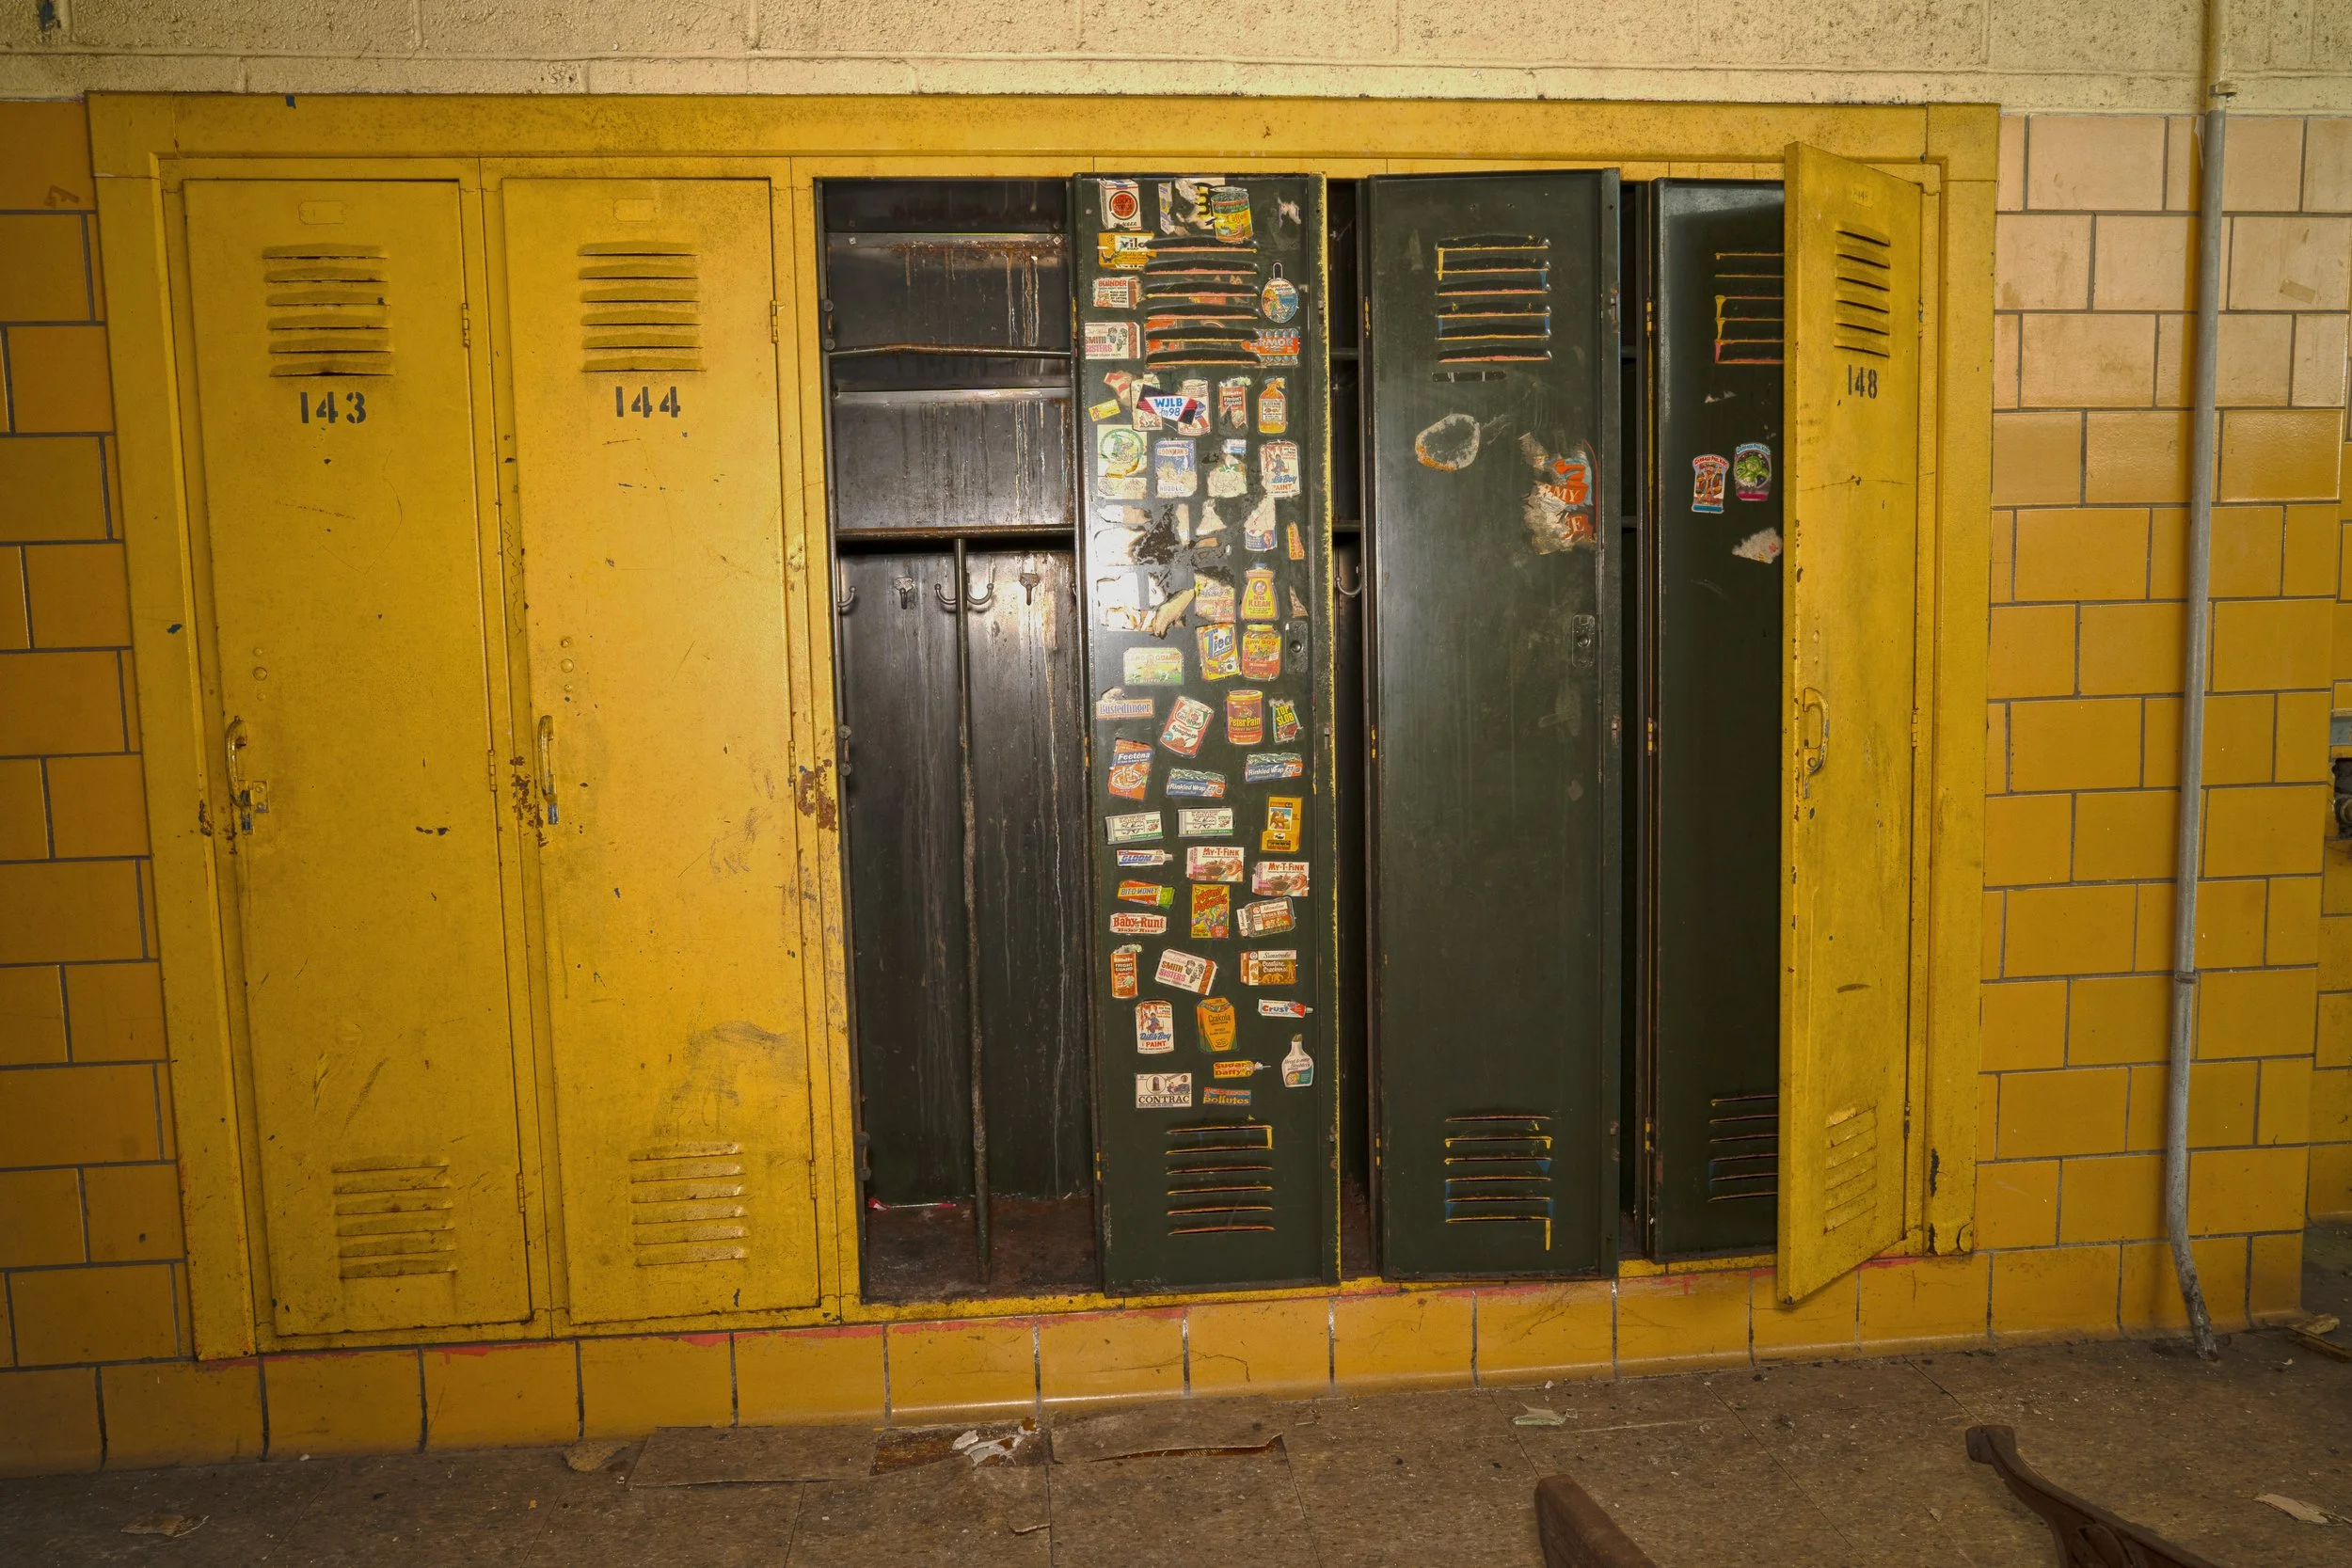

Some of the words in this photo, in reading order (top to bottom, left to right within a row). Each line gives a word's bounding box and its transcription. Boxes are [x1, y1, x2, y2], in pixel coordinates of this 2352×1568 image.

[1098, 278, 1127, 287] BLUNDER
[1085, 336, 1106, 344] SMITH
[1085, 344, 1113, 353] SISTERS
[1848, 364, 1877, 399] 148
[300, 391, 367, 424] 143
[614, 386, 681, 419] 144
[1153, 397, 1183, 408] WJLB
[1168, 407, 1181, 417] 98
[1693, 455, 1711, 466] GARBAGE
[1276, 705, 1290, 716] TOP
[1229, 716, 1246, 727] Peter
[1247, 716, 1261, 726] Pain
[1276, 712, 1295, 726] SLOB
[1248, 767, 1270, 776] Rinkled
[1270, 766, 1284, 774] Wrap
[1120, 854, 1152, 863] GLOOM
[1120, 887, 1158, 895] BIT-O-MONEY
[1112, 916, 1137, 927] Baby
[1139, 917, 1165, 928] Runt
[1161, 960, 1184, 974] SMITH
[1158, 968, 1186, 982] SISTERS
[1262, 1004, 1289, 1013] Crust
[1157, 1031, 1172, 1041] Boy
[1138, 1095, 1190, 1104] CONTRAC
